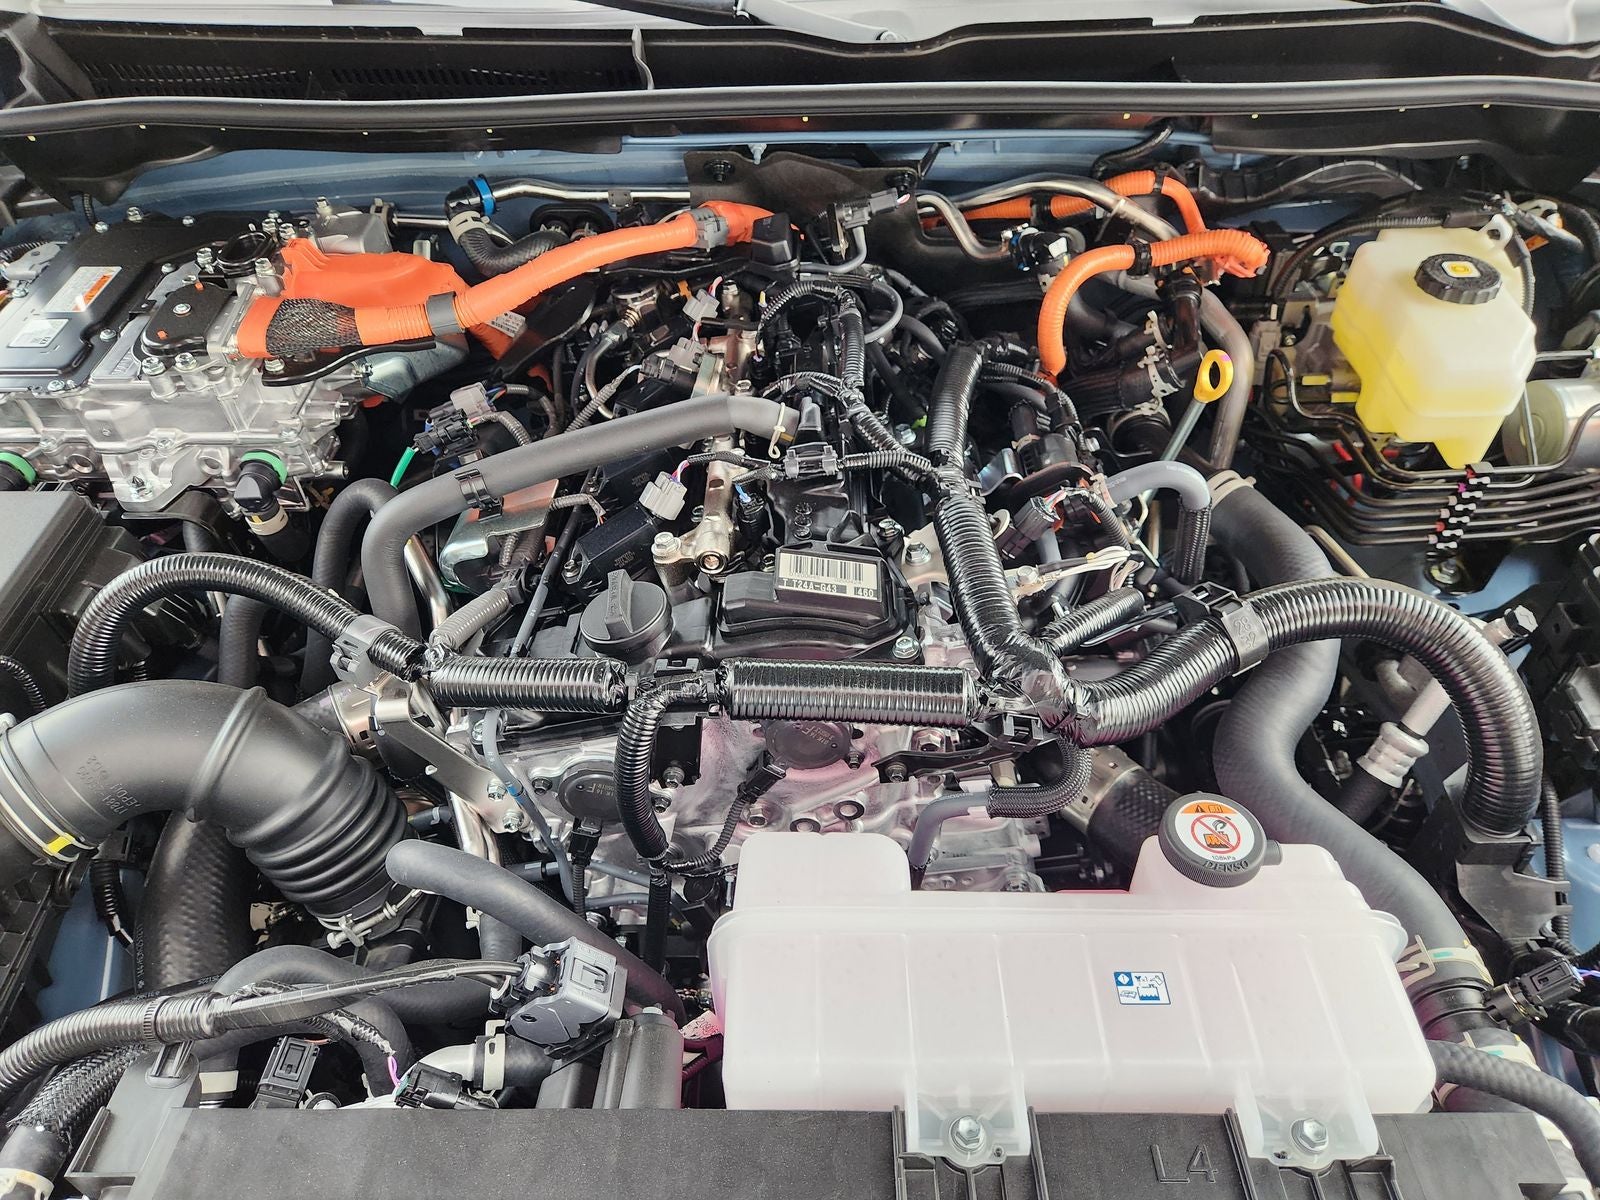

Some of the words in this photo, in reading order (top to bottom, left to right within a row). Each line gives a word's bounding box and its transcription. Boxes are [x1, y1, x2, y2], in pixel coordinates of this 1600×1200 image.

[792, 580, 838, 593] T24A-G43
[1203, 859, 1249, 873] DENSO
[1149, 1143, 1219, 1184] L4
